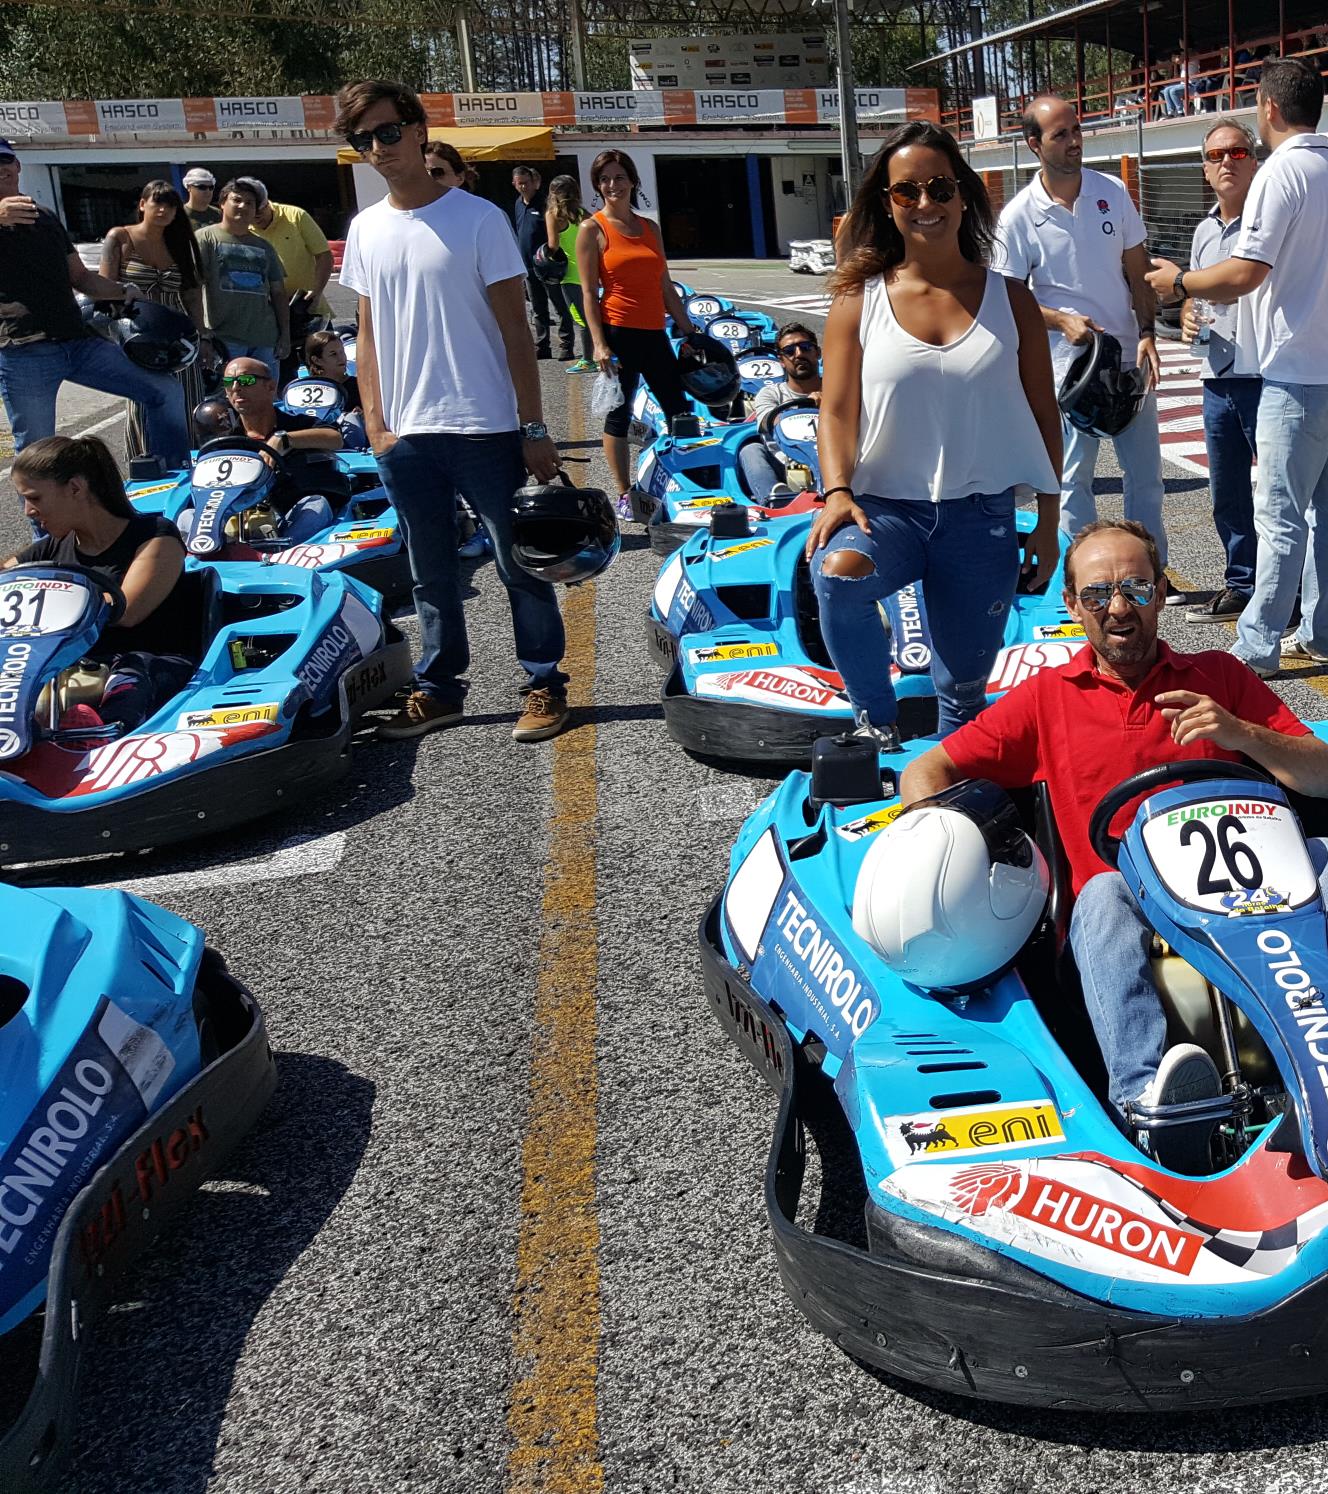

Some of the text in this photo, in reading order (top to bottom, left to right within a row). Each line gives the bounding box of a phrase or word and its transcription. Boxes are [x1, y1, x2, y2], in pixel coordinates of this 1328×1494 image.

[220, 102, 277, 116] HASCO
[458, 98, 517, 111] HASCO
[700, 95, 758, 108] HASCO
[821, 94, 879, 107] HACO
[0, 107, 39, 121] ASCO
[101, 105, 158, 118] HASCO
[697, 303, 713, 313] 20
[722, 325, 739, 336] 28
[752, 363, 773, 376] 22
[302, 388, 323, 403] 32
[216, 459, 233, 482] 9
[0, 582, 73, 591] UROINDY
[0, 589, 46, 628] 31
[898, 583, 923, 643] TECNIRO
[728, 643, 773, 659] eni
[754, 674, 828, 703] HURON
[223, 705, 272, 725] eni
[1167, 803, 1277, 827] EUROINDY
[1180, 814, 1264, 896] 26
[1229, 888, 1271, 907] 24
[774, 944, 803, 985] ENGENHARIA
[776, 891, 873, 1036] TECNIROLO
[968, 1105, 1052, 1147] eni
[0, 1058, 113, 1270] ECNIROLO
[1031, 1184, 1187, 1265] HURON
